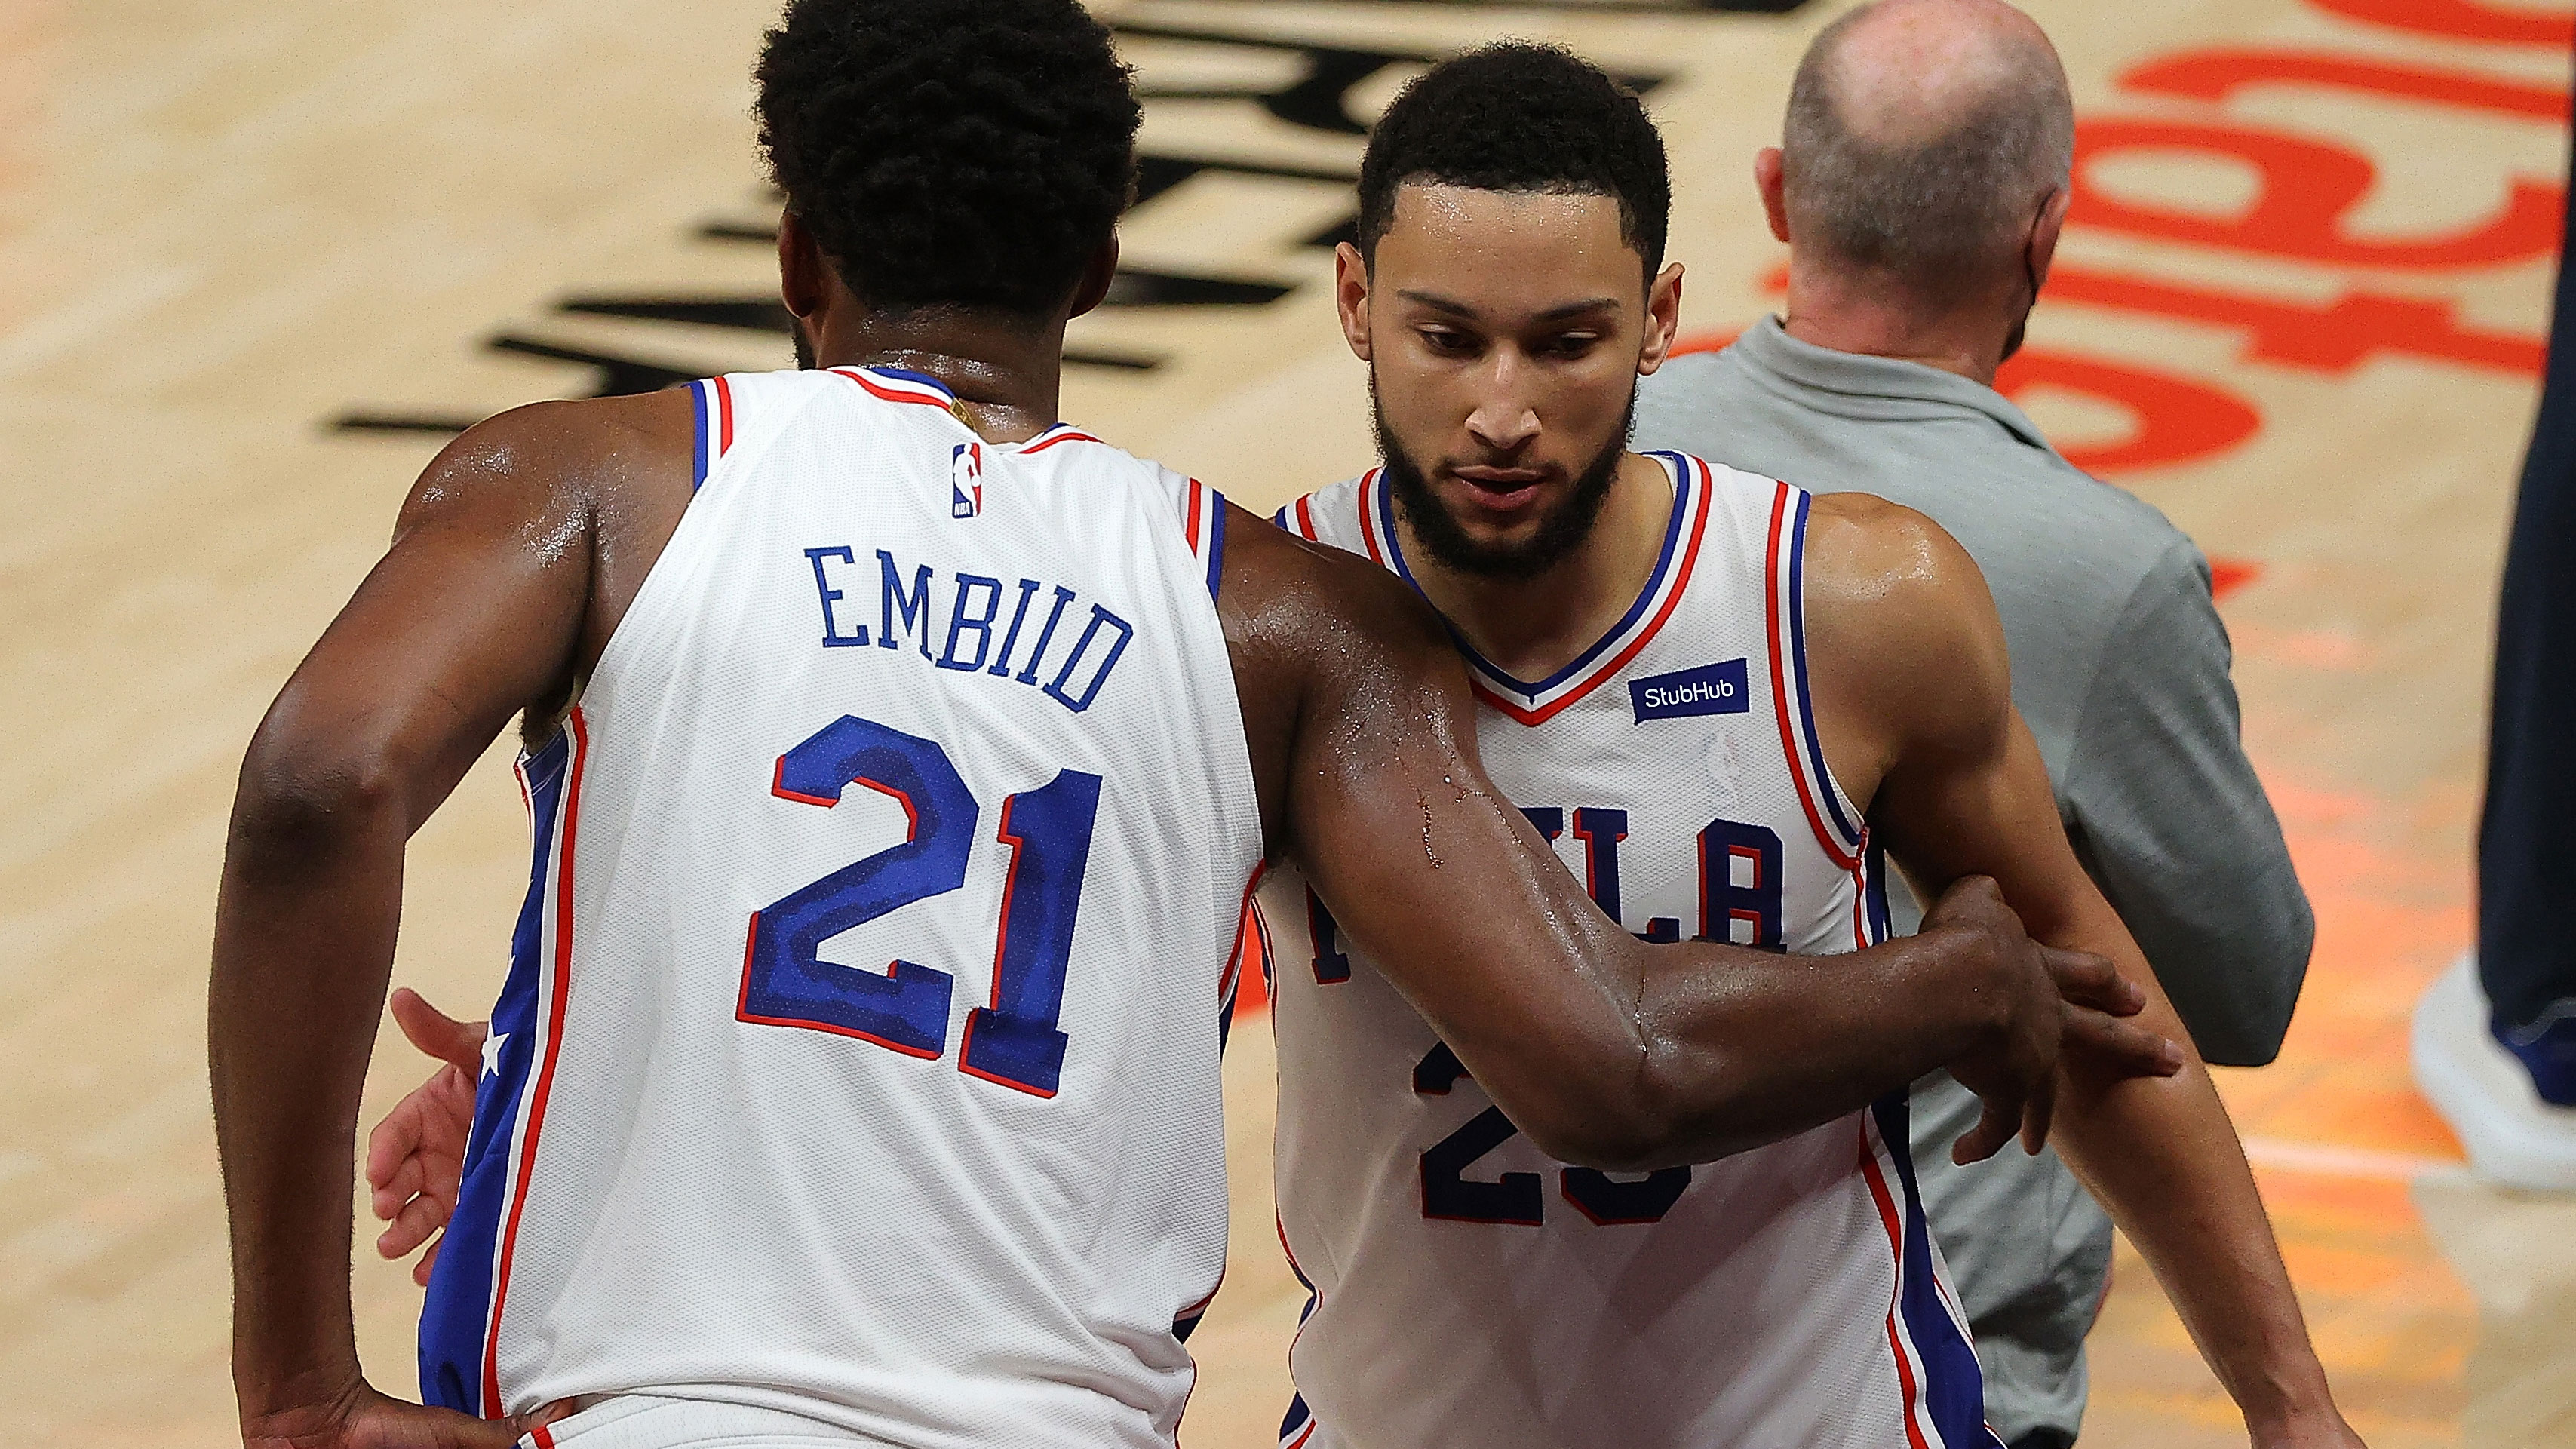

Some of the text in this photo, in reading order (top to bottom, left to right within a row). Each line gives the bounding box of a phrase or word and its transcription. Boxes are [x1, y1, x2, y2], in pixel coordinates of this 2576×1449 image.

[954, 502, 971, 516] NBA
[805, 545, 1134, 714] EMBIID
[1644, 679, 1734, 708] StubHub
[735, 714, 1104, 1100] 21
